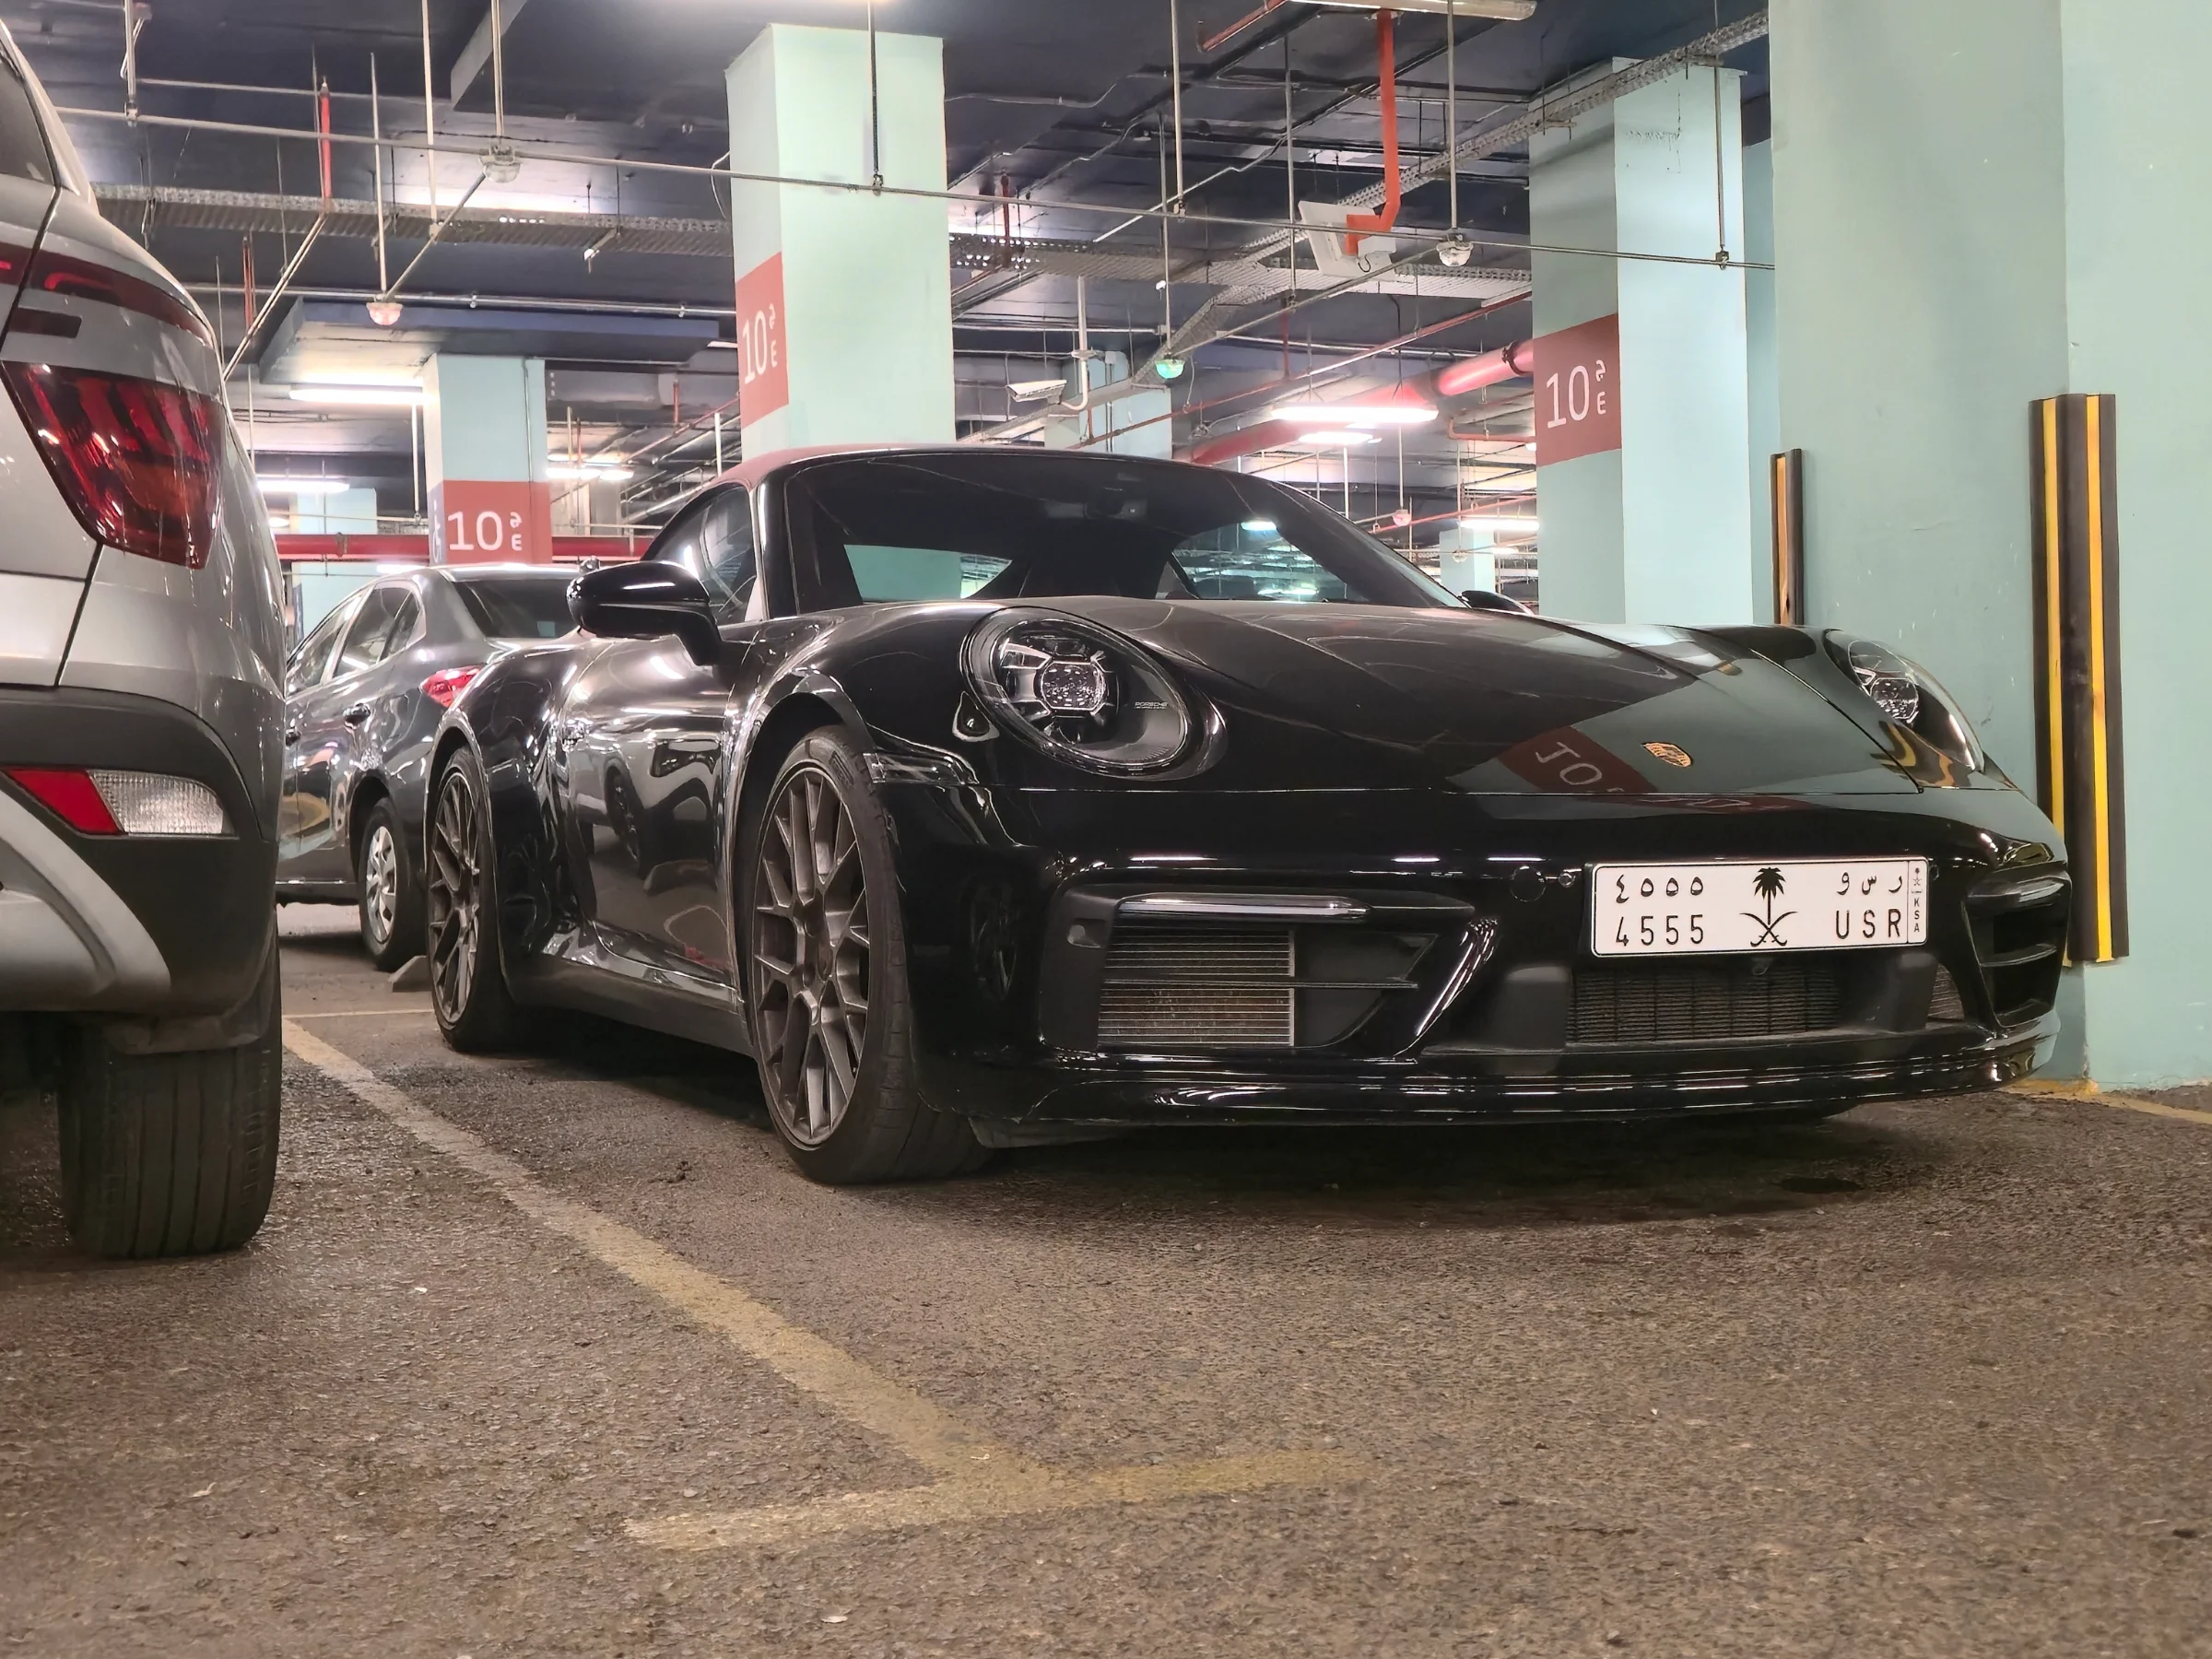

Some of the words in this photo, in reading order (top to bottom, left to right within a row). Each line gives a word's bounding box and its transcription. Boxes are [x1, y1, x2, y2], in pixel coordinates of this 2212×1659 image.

[742, 310, 768, 385] 10
[771, 339, 778, 369] E
[1546, 365, 1590, 429] 10
[1596, 391, 1606, 415] E
[447, 511, 503, 551] 10
[511, 534, 524, 551] E
[1616, 913, 1704, 947] 4555
[1835, 908, 1902, 939] USR
